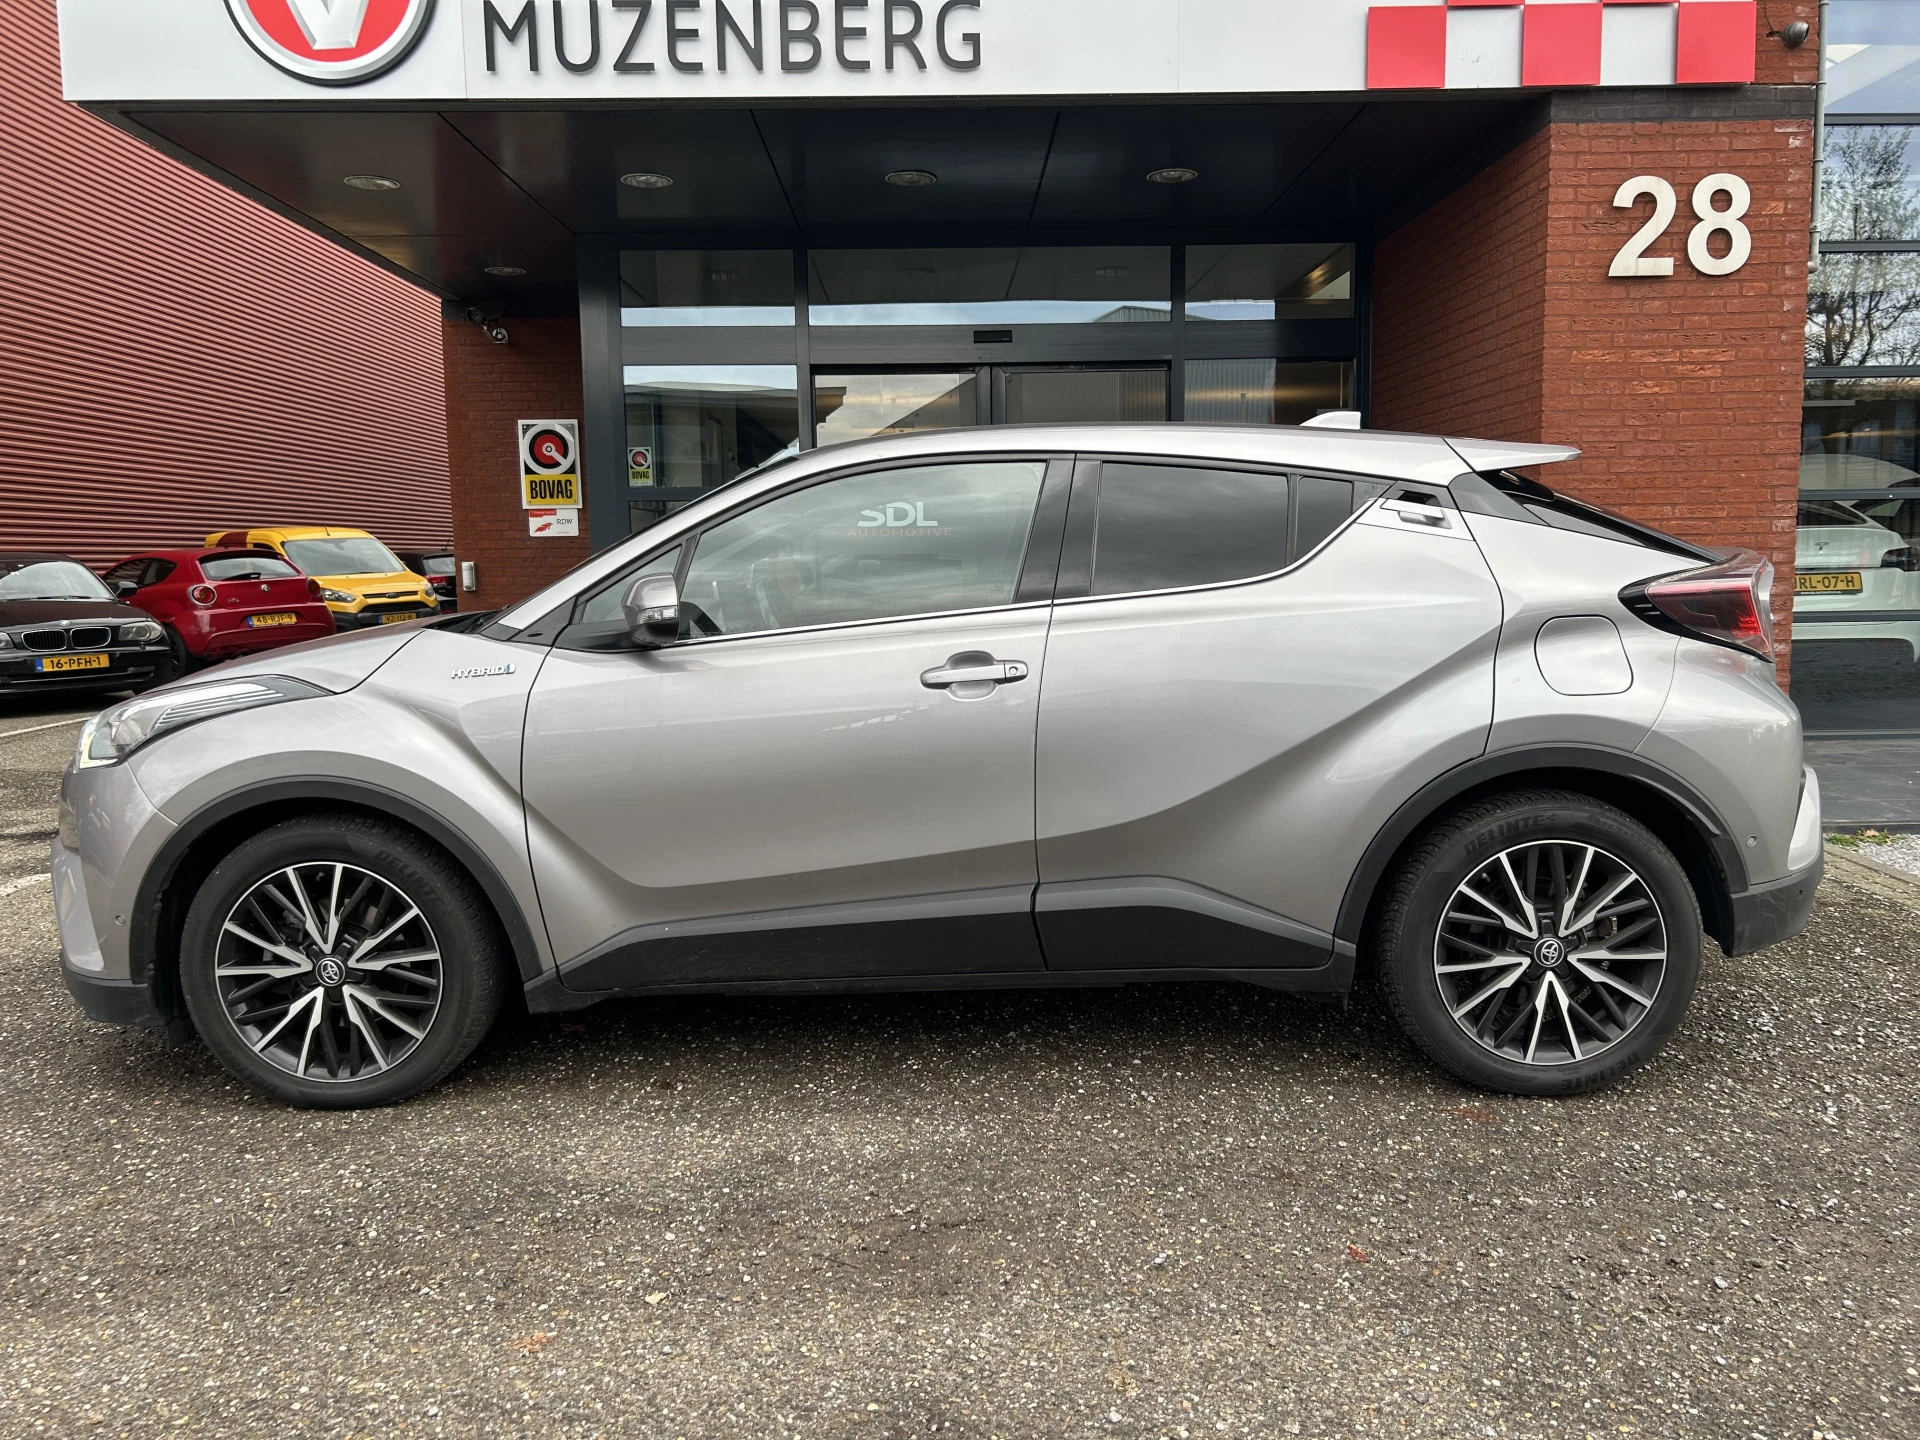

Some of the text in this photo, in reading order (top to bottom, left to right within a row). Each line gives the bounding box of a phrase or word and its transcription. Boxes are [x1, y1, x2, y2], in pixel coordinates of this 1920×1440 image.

[484, 0, 981, 72] MUZENBERG
[1608, 173, 1752, 277] 28
[629, 470, 650, 480] BOVAG
[529, 479, 573, 499] BOVAG
[857, 501, 939, 528] SDL
[846, 527, 953, 538] AUTOMOTIVE
[256, 613, 293, 624] 48-RJF-9
[50, 656, 101, 670] 16-PFH-1
[450, 665, 506, 679] HYBRID
